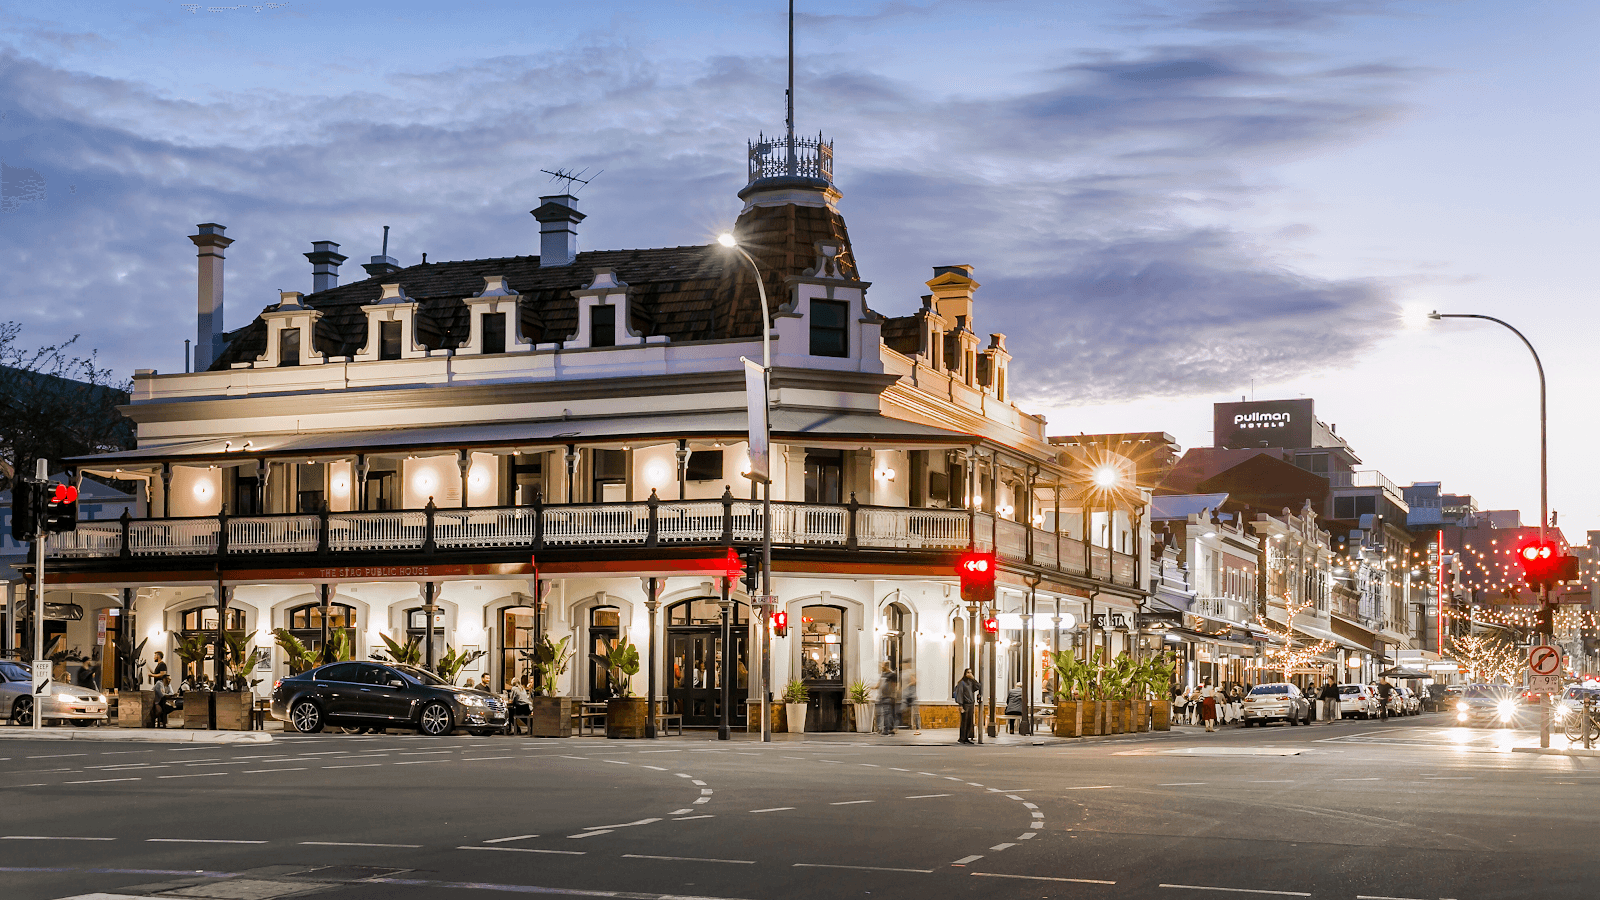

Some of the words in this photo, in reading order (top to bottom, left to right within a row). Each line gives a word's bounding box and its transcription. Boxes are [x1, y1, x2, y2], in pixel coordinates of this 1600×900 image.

[1234, 411, 1291, 424] pullman
[320, 568, 336, 578] THE
[339, 567, 362, 577] STAG
[365, 567, 397, 577] PUBLIC
[399, 566, 429, 576] HOUSE
